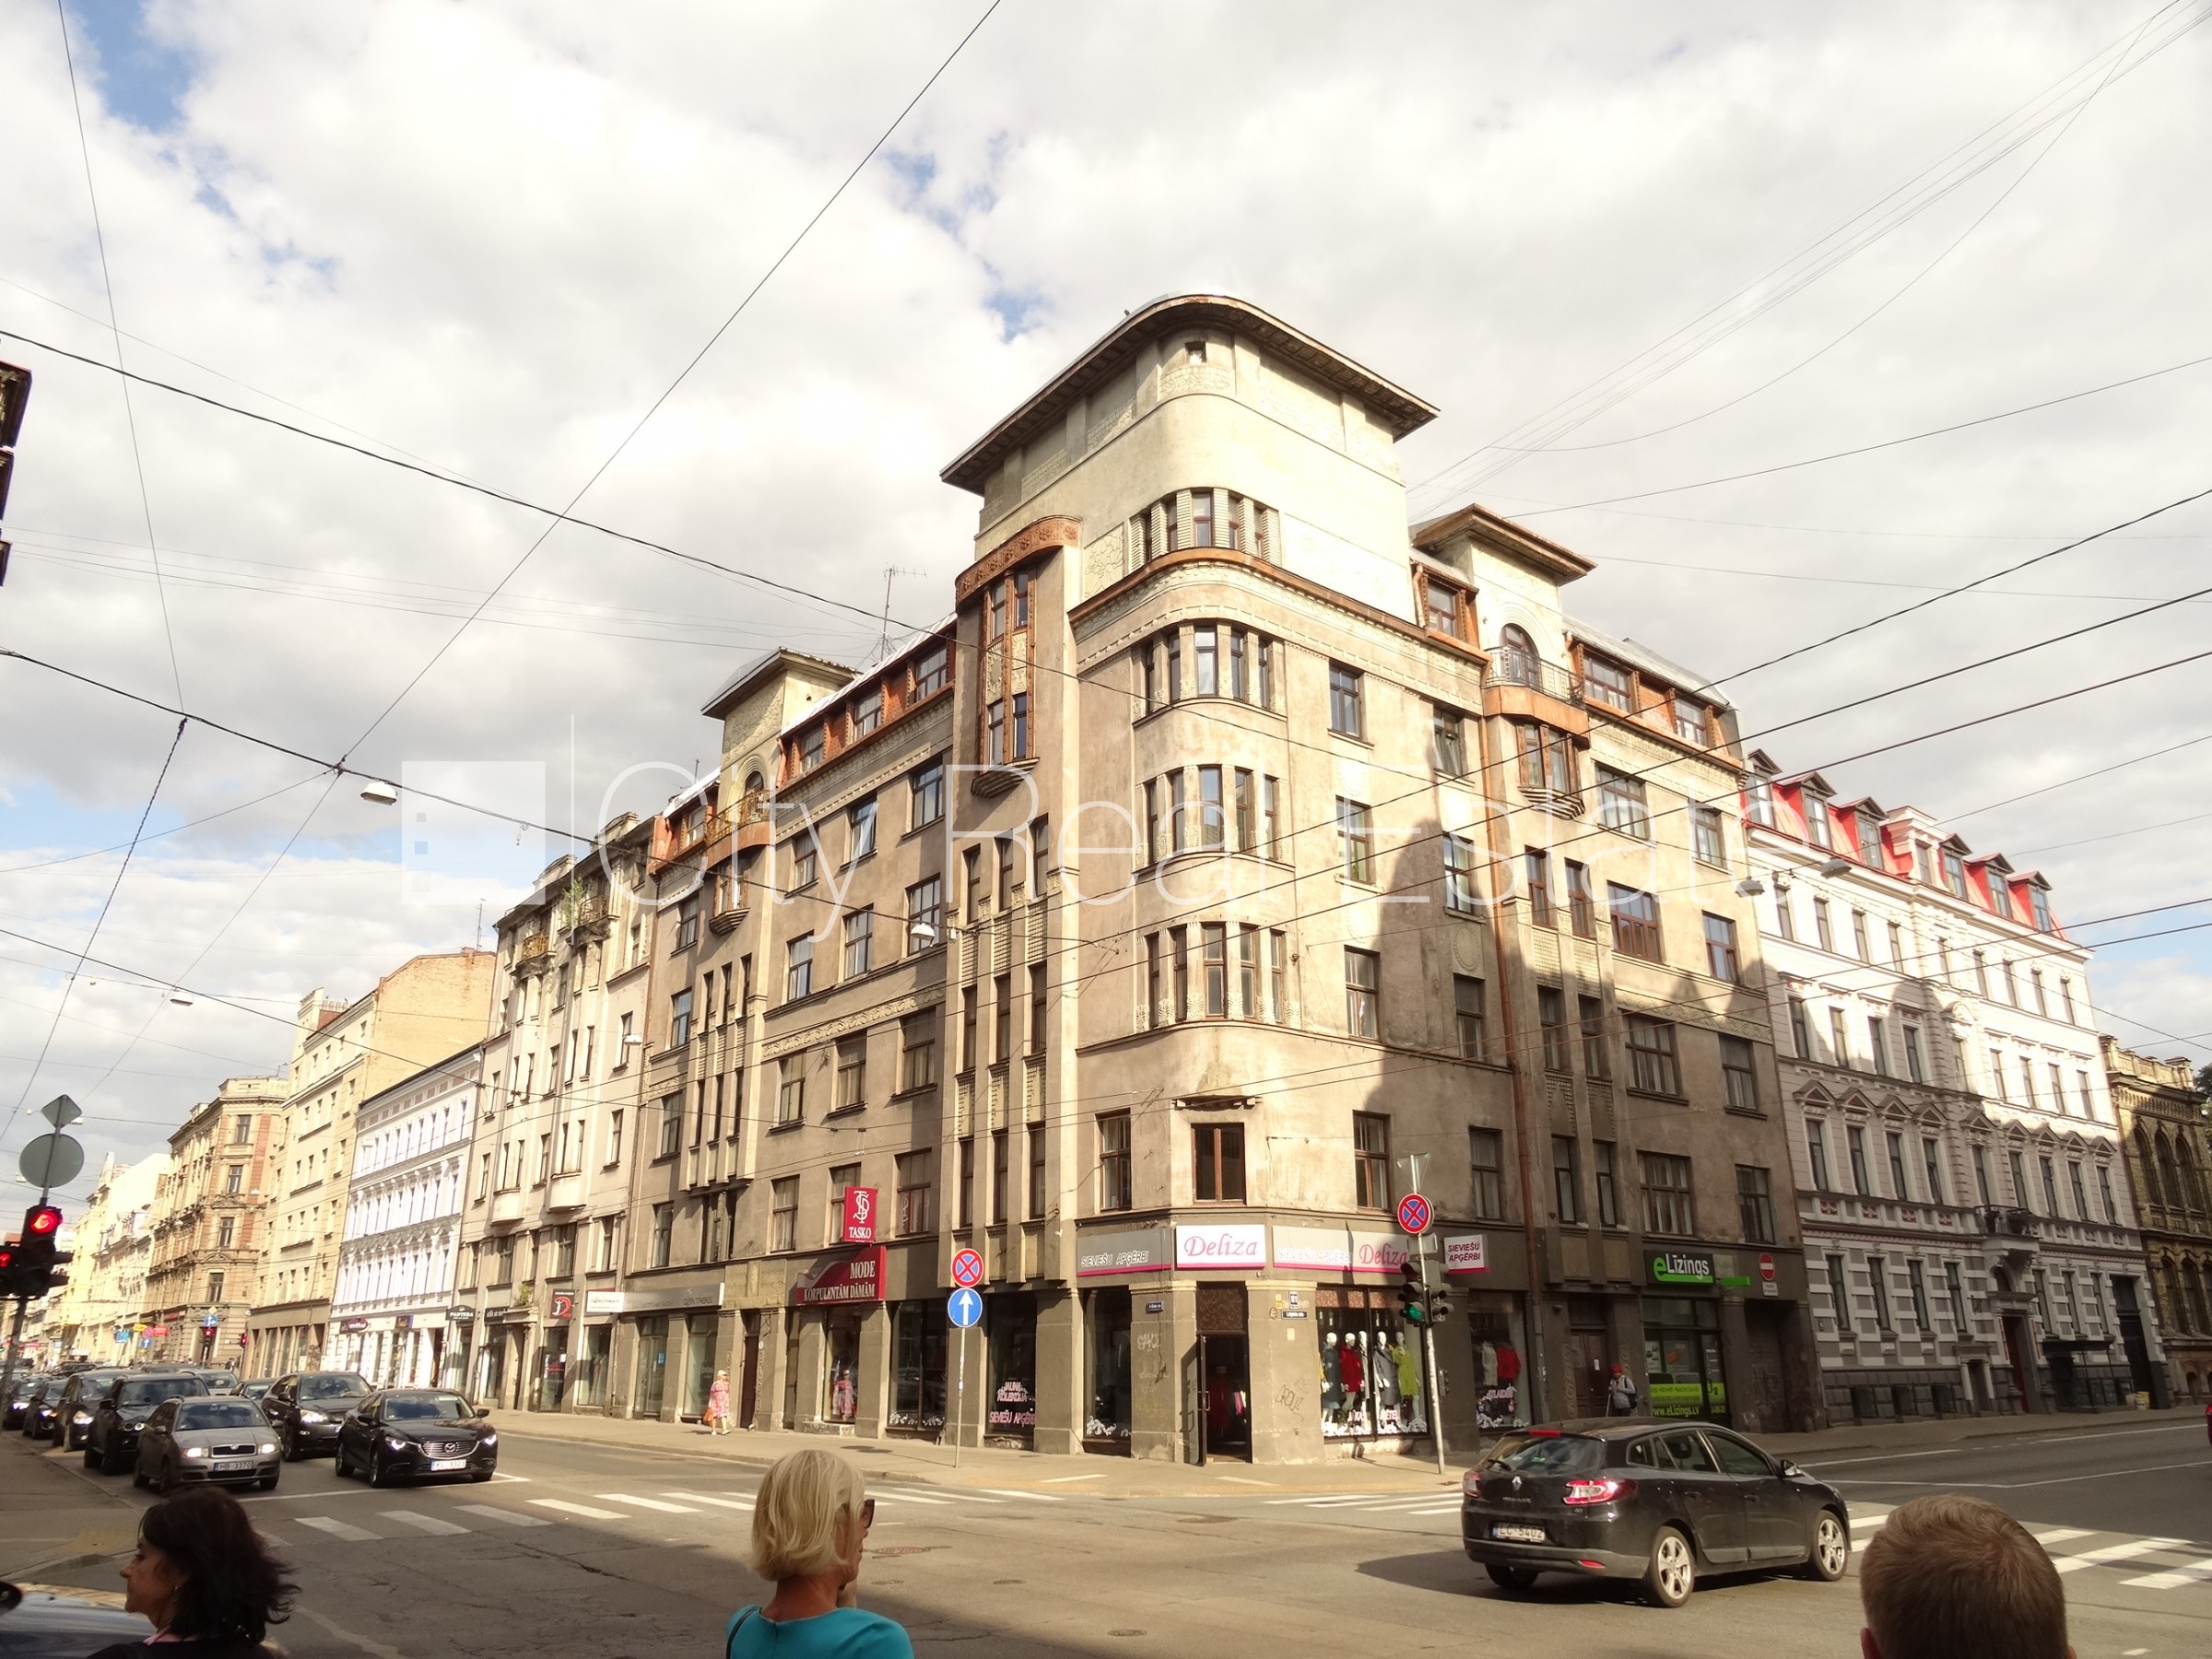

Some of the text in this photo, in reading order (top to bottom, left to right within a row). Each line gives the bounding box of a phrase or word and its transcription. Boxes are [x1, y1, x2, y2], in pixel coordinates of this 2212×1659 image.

[849, 1227, 871, 1239] TASKO
[1183, 1232, 1258, 1257] Deliza
[1447, 1241, 1480, 1253] SIEVIEŠU
[1081, 1250, 1149, 1267] SIEVIEŠU APĢĒRBI
[1359, 1242, 1407, 1265] Deliza
[1448, 1252, 1481, 1263] APĢĒRBI
[850, 1261, 876, 1279] MODE
[804, 1282, 876, 1301] KORPULENTĀM DĀMĀM
[1500, 1524, 1544, 1538] LC-5402
